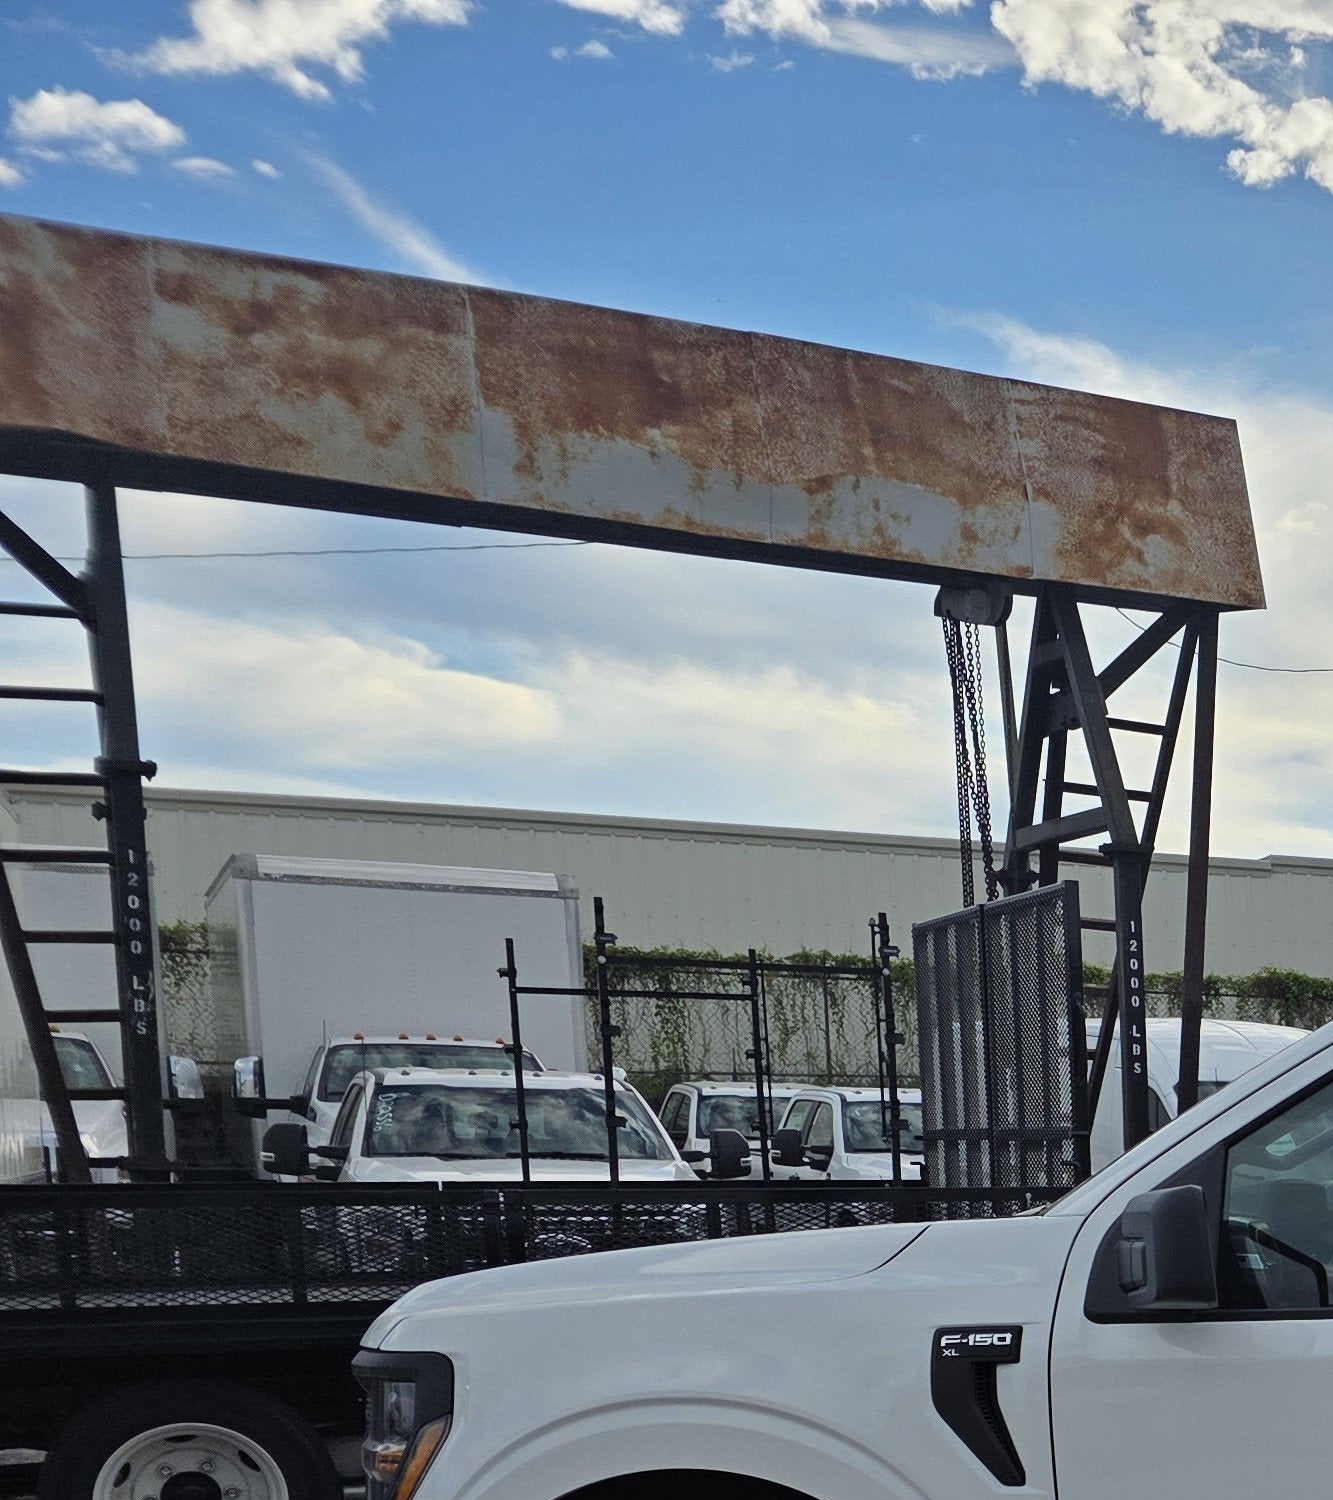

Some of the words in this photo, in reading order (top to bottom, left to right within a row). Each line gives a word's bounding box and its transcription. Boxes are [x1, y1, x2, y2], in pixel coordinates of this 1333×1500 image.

[127, 849, 142, 955] 12000
[1129, 920, 1140, 1008] 12000
[132, 975, 147, 1035] LBS
[1131, 1024, 1142, 1074] LBS
[940, 1332, 1013, 1347] F-150
[942, 1348, 960, 1357] XL
